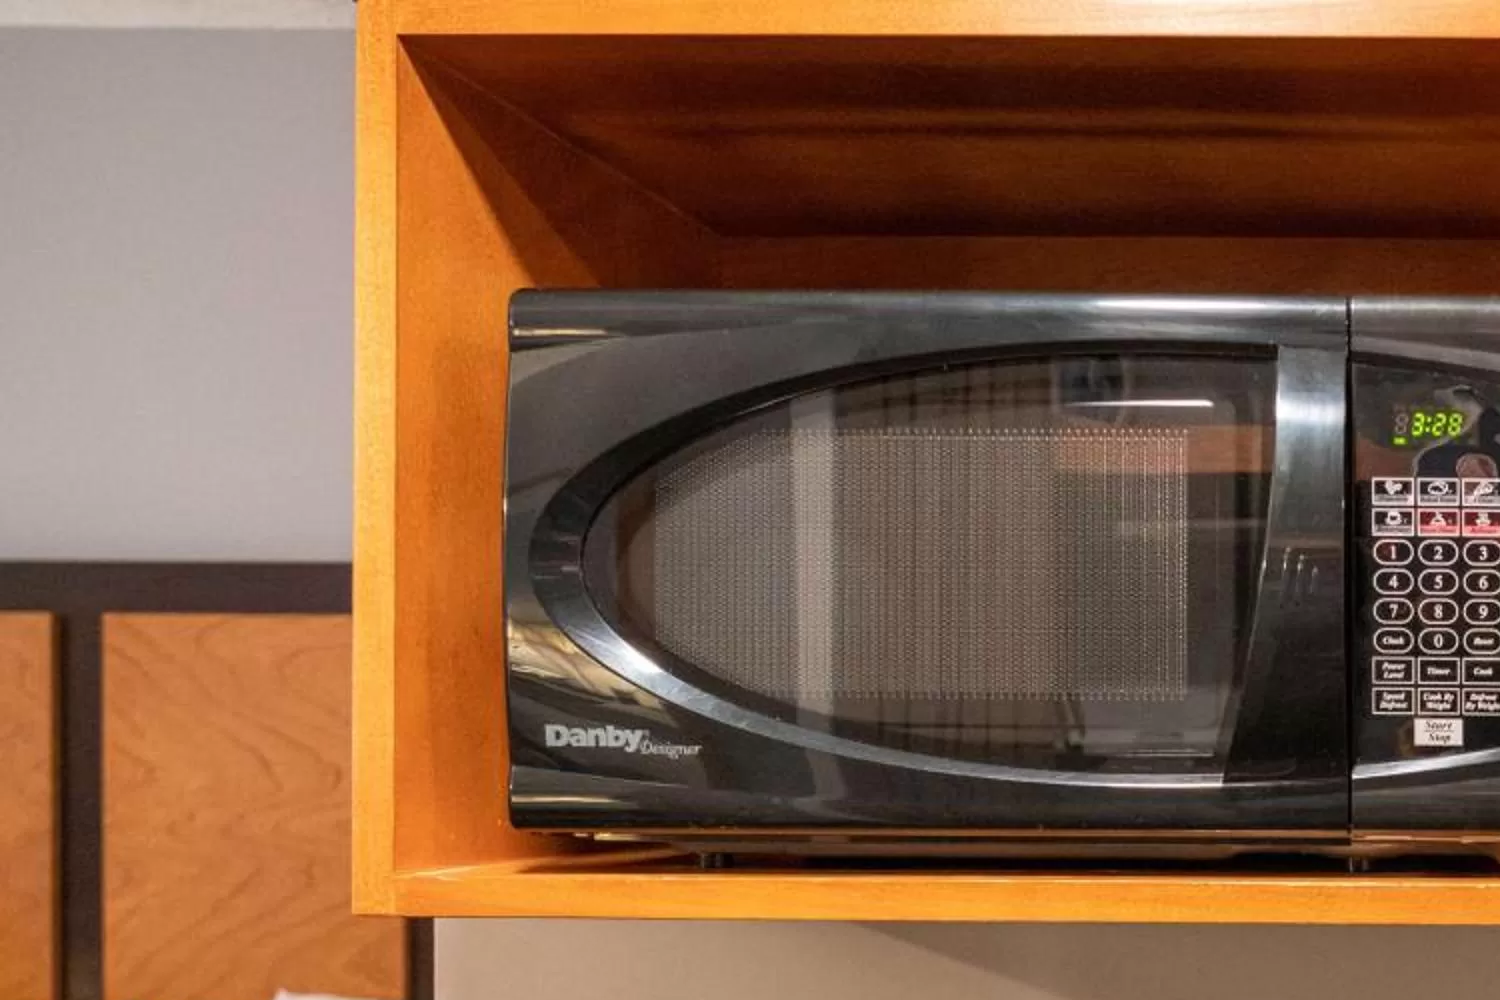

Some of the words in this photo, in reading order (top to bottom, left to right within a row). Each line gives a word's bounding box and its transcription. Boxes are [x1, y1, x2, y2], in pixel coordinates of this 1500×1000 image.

[1411, 411, 1463, 437] 3:28
[1389, 546, 1397, 560] 1
[1433, 546, 1443, 560] 2
[1479, 546, 1488, 560] 3
[1388, 576, 1398, 589] 4
[1433, 577, 1443, 590] 5
[1479, 577, 1489, 590] 6
[1389, 604, 1399, 618] 7
[1433, 605, 1443, 618] 8
[1478, 605, 1488, 619] 9
[1433, 634, 1443, 648] 0
[544, 724, 644, 753] Danby
[640, 739, 702, 760] Designer
